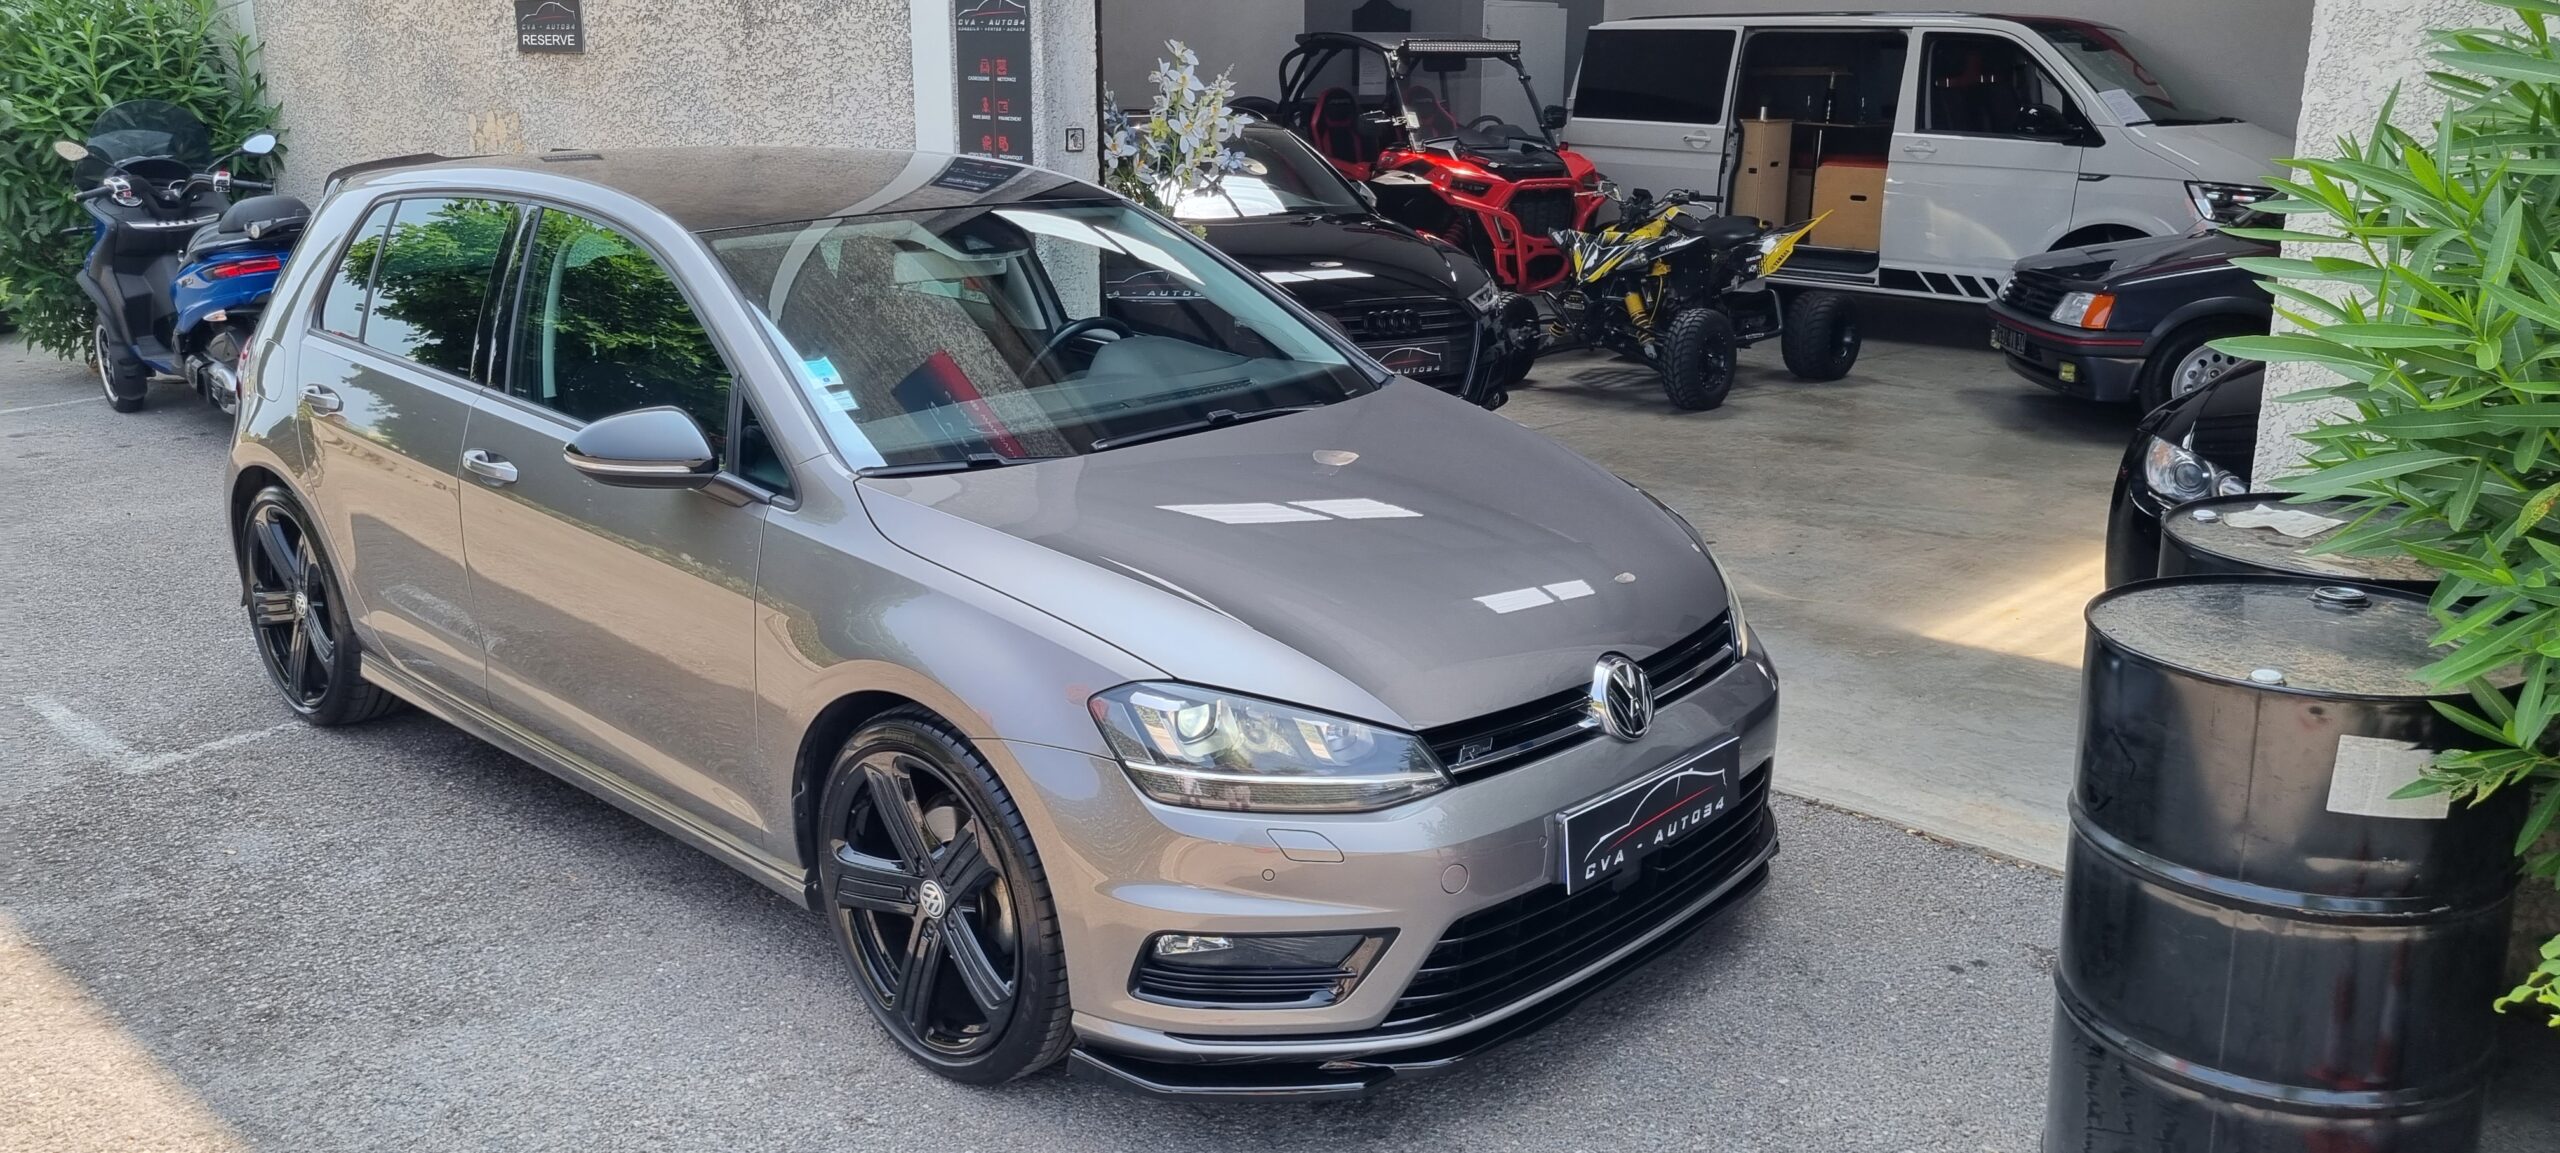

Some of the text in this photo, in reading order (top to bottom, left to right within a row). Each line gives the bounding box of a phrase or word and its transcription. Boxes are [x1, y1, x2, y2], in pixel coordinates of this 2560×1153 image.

[522, 34, 576, 46] RESERVE
[1584, 849, 1625, 881] CVA
[1653, 796, 1725, 845] AUTO34
